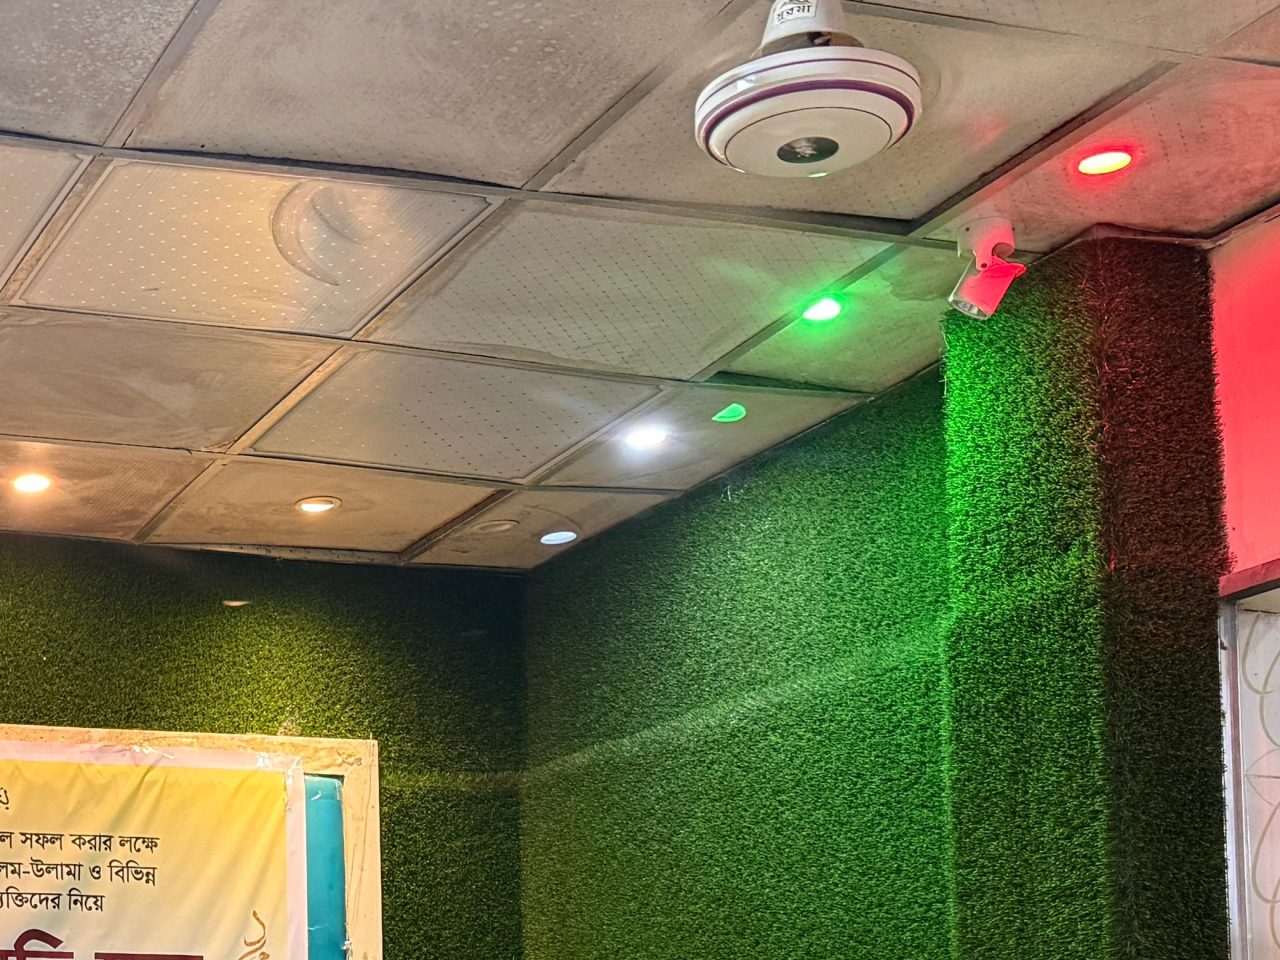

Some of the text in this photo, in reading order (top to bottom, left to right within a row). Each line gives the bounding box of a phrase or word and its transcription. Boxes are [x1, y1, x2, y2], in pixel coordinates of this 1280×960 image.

[20, 831, 65, 851] সফল
[70, 833, 114, 852] করার
[89, 864, 102, 880] ও
[107, 859, 158, 886] বিভিন্ন
[67, 887, 106, 912] নিয়ে
